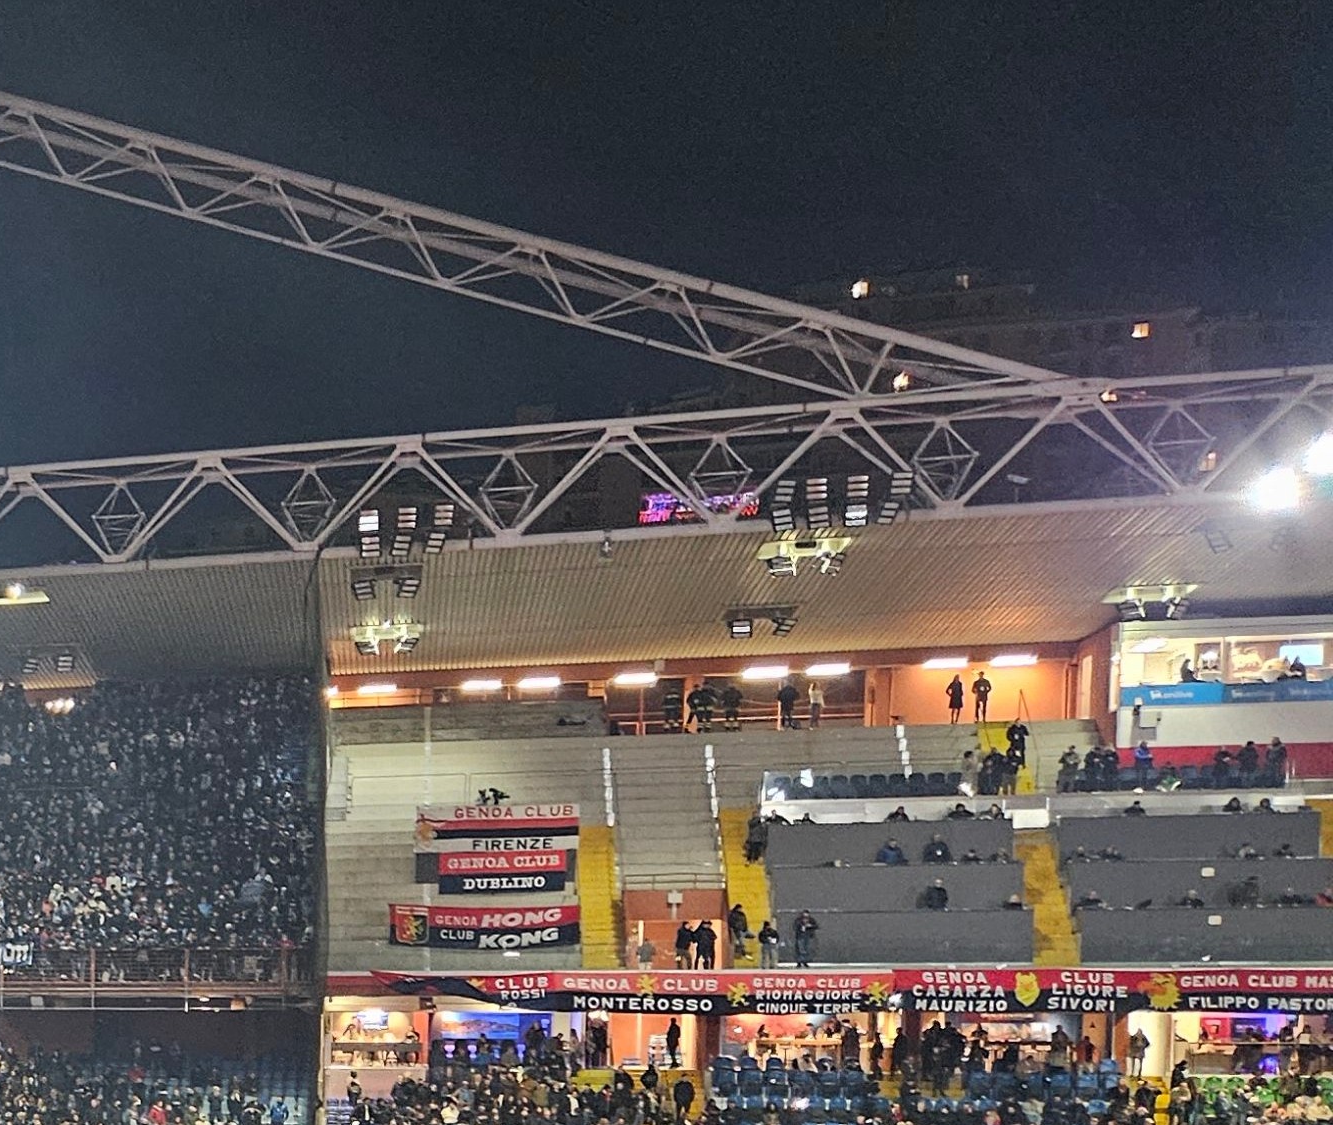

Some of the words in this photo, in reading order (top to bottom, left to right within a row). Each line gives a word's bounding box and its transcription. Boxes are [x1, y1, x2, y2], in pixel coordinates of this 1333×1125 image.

[454, 805, 514, 819] GENOA
[525, 804, 575, 818] CLUB
[472, 838, 554, 851] FIRENZE
[447, 857, 510, 870] GENOA
[513, 854, 561, 868] CLUB
[463, 876, 547, 891] DUBLINO
[434, 914, 478, 927] GENOA
[481, 907, 563, 929] HONG
[439, 929, 476, 941] CLUB
[478, 927, 560, 950] KONG
[494, 976, 550, 989] CLUB
[563, 977, 630, 991] GENOA
[662, 978, 719, 992] CLUB
[753, 977, 807, 988] GENOA
[817, 977, 861, 989] CLUB
[921, 971, 988, 985] GENOA
[1060, 971, 1115, 984] CLUB
[1180, 975, 1240, 988] GENOA
[1247, 975, 1299, 989] CLUB
[1305, 975, 1333, 989] MA
[500, 988, 546, 1000] ROSSI
[755, 988, 862, 1001] RIOMAGGIORE
[912, 984, 1006, 999] CASARZA
[1051, 983, 1129, 999] LIGURE
[573, 996, 713, 1012] MONTEROSSO
[756, 1002, 809, 1014] CINQUE
[814, 1002, 861, 1014] TERRE
[915, 998, 1009, 1013] MAURIZIO
[1047, 996, 1116, 1012] SIVORI
[1188, 996, 1260, 1010] FILIPPO
